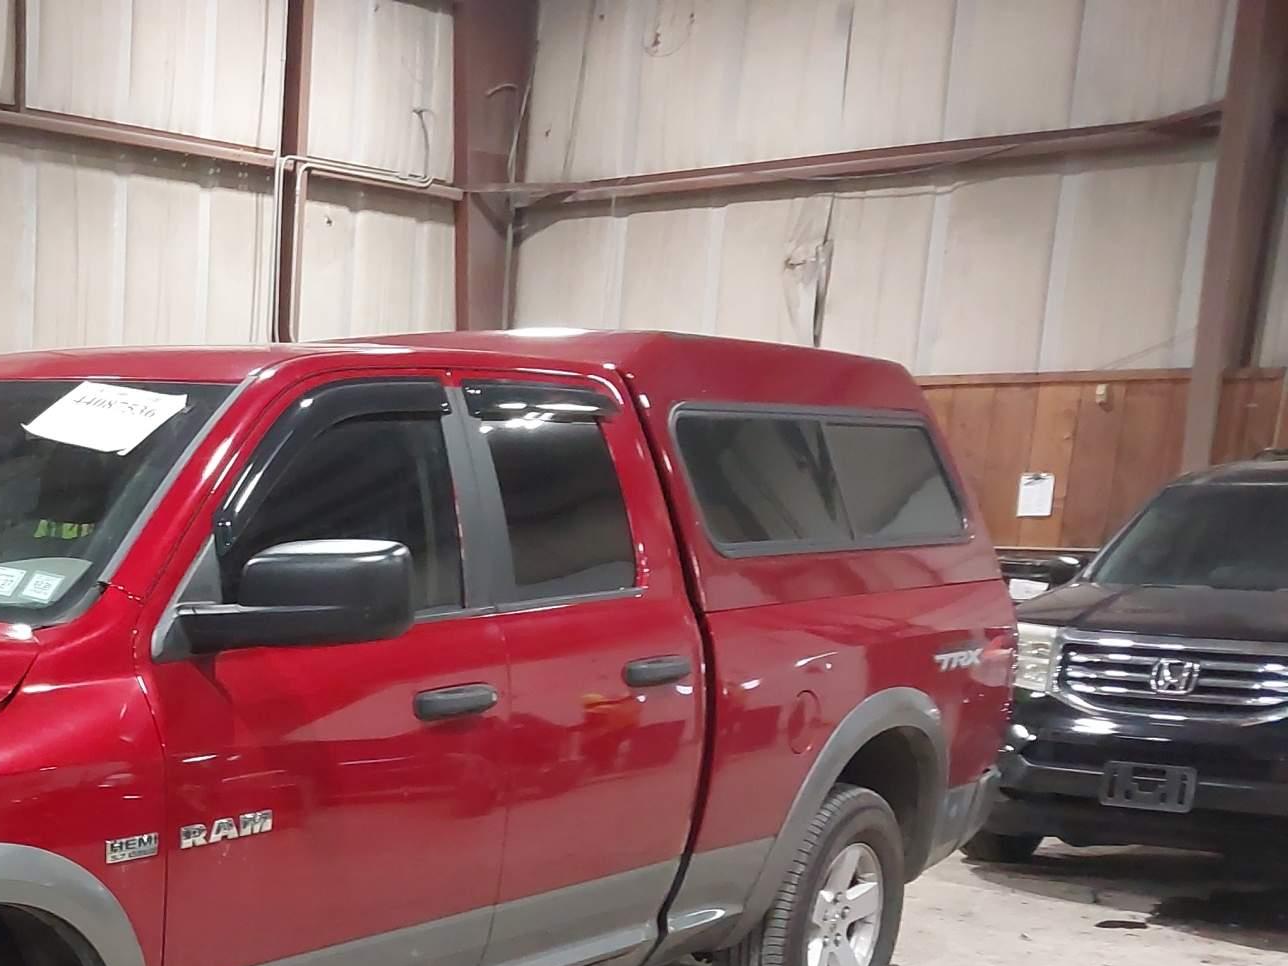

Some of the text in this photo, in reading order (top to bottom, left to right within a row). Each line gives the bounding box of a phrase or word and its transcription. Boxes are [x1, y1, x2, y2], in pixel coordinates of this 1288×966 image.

[934, 647, 984, 672] TRX
[180, 809, 273, 849] RAM
[110, 833, 158, 852] HEMI
